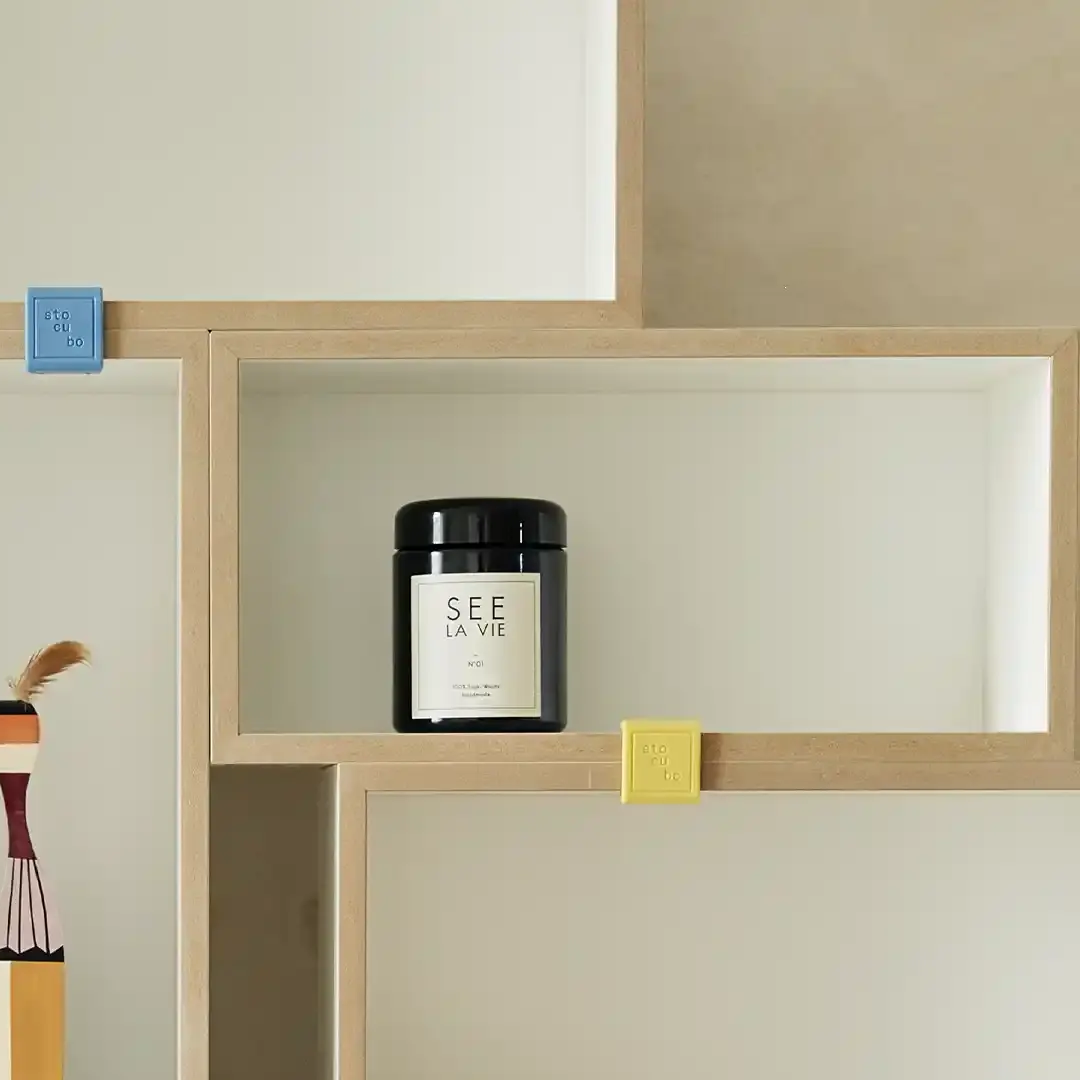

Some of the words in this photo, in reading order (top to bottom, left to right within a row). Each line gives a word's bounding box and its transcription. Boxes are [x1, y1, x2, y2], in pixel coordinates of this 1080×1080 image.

[44, 309, 70, 320] sto
[53, 323, 71, 333] cu
[67, 336, 84, 347] bo
[447, 596, 505, 621] SEE
[446, 624, 467, 638] LA
[477, 623, 505, 637] VIE
